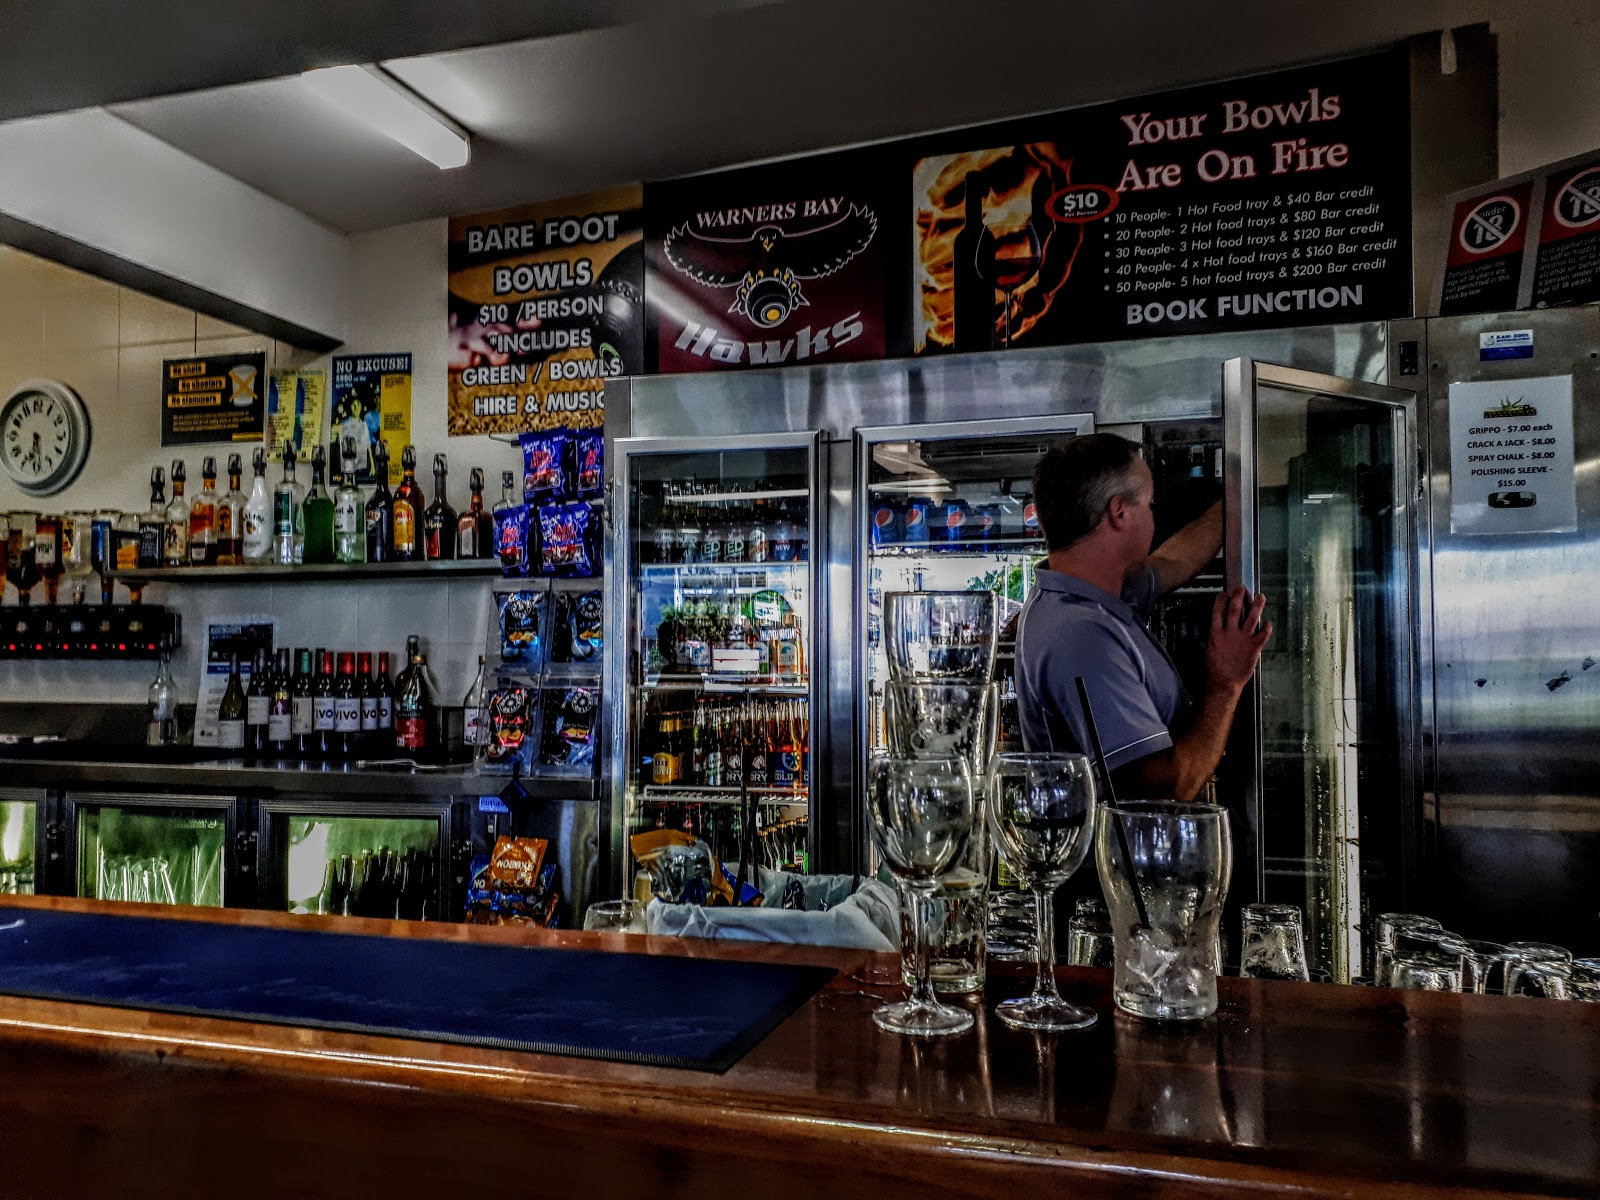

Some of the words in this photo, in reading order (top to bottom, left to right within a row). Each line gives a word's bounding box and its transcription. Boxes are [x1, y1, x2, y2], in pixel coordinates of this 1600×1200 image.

[1121, 112, 1207, 146] Your
[1222, 87, 1342, 134] Bowls
[1116, 158, 1181, 194] Are
[1197, 148, 1256, 183] On
[1271, 138, 1349, 175] Fire
[696, 199, 797, 228] WARNERS
[802, 196, 844, 217] BAY
[1064, 192, 1099, 212] $10
[1116, 213, 1126, 224] 10
[1130, 208, 1172, 223] People-
[1178, 206, 1182, 217] 1
[1187, 204, 1208, 216] Hot
[1212, 200, 1242, 213] Food
[1246, 199, 1269, 211] tray
[1272, 195, 1282, 207] &
[1286, 192, 1310, 206] $40
[1315, 191, 1336, 202] Bar
[1339, 185, 1374, 200] credit
[468, 224, 534, 254] BARE
[545, 213, 619, 245] FOOT
[1116, 230, 1130, 241] 20
[1134, 225, 1175, 239] People-
[1180, 224, 1187, 235] 2
[1191, 221, 1212, 233] Hot
[1216, 217, 1243, 231] food
[1247, 217, 1276, 228] trays
[1280, 213, 1289, 224] &
[1293, 210, 1316, 223] $80
[1320, 208, 1342, 220] Bar
[1345, 203, 1380, 217] credit
[1116, 247, 1130, 259] 30
[1134, 243, 1175, 257] People-
[1180, 241, 1187, 252] 3
[1191, 239, 1212, 251] Hot
[1216, 235, 1243, 248] food
[1247, 235, 1275, 246] trays
[1280, 231, 1289, 242] &
[1293, 228, 1320, 242] $120
[1325, 226, 1346, 238] Bar
[1349, 221, 1384, 235] credit
[1116, 264, 1131, 275] 40
[1135, 260, 1176, 275] People-
[1181, 258, 1188, 269] 4
[1192, 260, 1199, 268] x
[1203, 256, 1224, 268] Hot
[1228, 252, 1255, 265] food
[1259, 251, 1288, 263] trays
[1292, 248, 1301, 259] &
[1306, 244, 1333, 258] $160
[1337, 243, 1359, 254] Bar
[1362, 238, 1398, 252] credit
[495, 260, 591, 293] BOWLS
[1116, 282, 1131, 293] 50
[1135, 277, 1176, 292] People-
[1180, 276, 1188, 287] 5
[1192, 275, 1211, 286] hot
[1215, 270, 1242, 283] food
[1246, 271, 1274, 282] trays
[1279, 267, 1288, 278] &
[1292, 263, 1323, 278] $200
[1327, 262, 1348, 274] Bar
[1352, 258, 1387, 271] credit
[479, 305, 509, 326] $10
[516, 295, 604, 323] /PERSON
[1126, 298, 1208, 325] BOOK
[1218, 284, 1363, 317] FUNCTION
[674, 311, 864, 366] Hawks
[336, 360, 353, 374] NO
[356, 356, 408, 373] EXCUSE!
[462, 364, 526, 386] GREEN
[532, 362, 543, 384] /
[474, 395, 517, 416] HIRE
[524, 395, 539, 413] &
[1467, 441, 1494, 449] CRACK
[1504, 439, 1525, 447] JACK
[1532, 438, 1556, 446] $8.00
[1469, 427, 1501, 435] GRIPPO
[1507, 425, 1531, 433] $7.00
[1468, 455, 1495, 463] SPRAY
[1497, 453, 1524, 461] CHALK
[1531, 452, 1555, 460] $8.00
[1471, 468, 1516, 476] POLISHING
[1518, 466, 1548, 474] SLEEVE
[1497, 480, 1526, 488] $15.00
[315, 709, 334, 719] IVO
